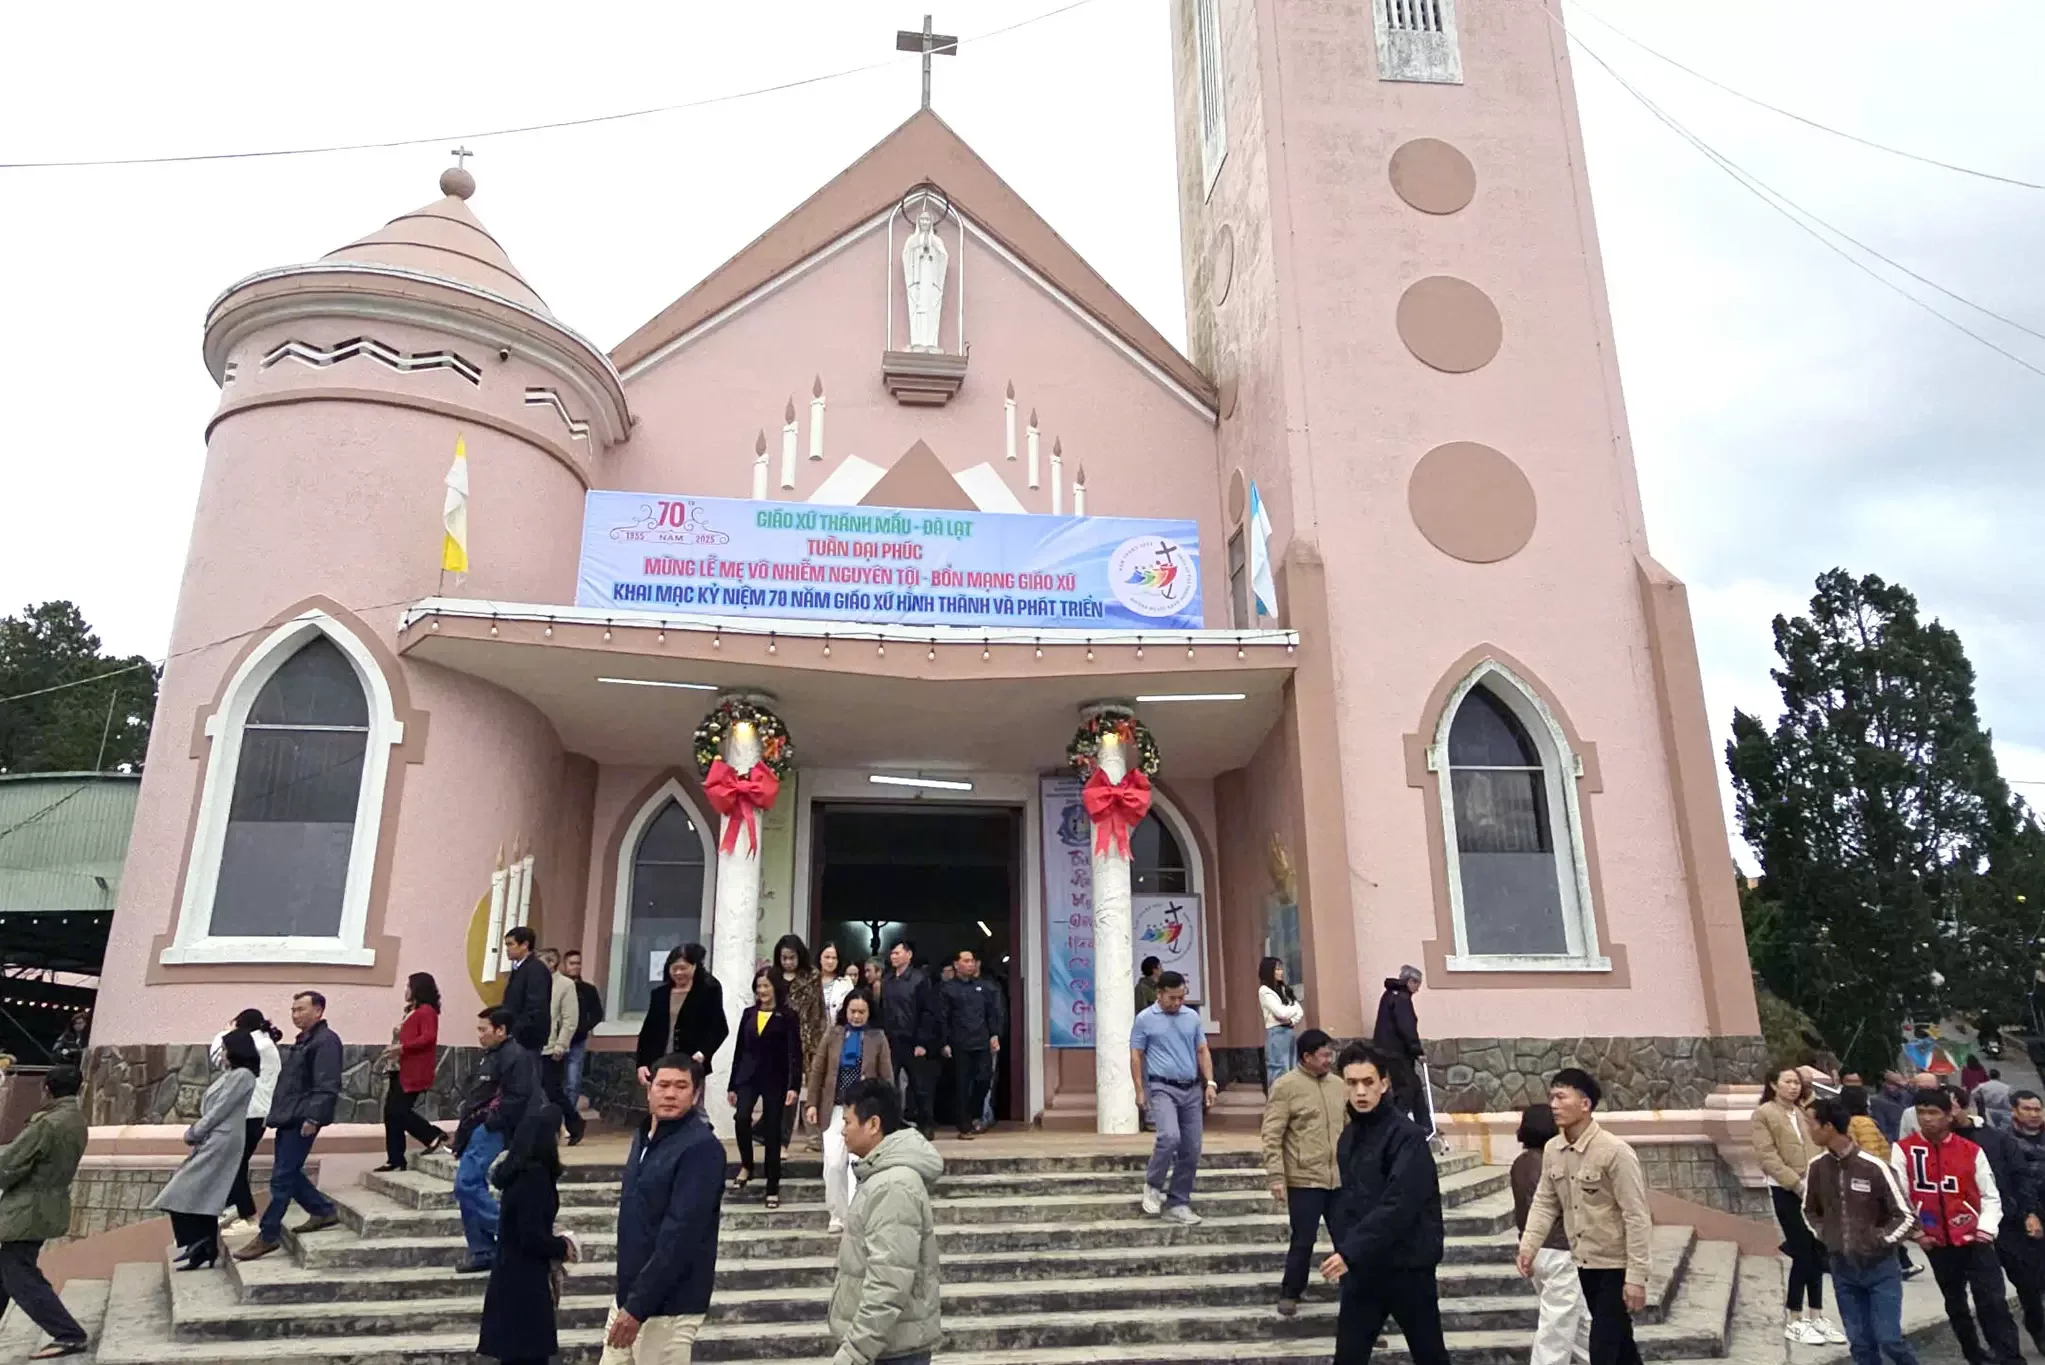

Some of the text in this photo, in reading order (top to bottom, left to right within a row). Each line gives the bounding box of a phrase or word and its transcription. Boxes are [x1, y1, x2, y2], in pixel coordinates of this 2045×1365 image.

[657, 501, 685, 528] 70
[696, 535, 715, 543] 2025
[719, 561, 745, 583] MẸ
[828, 565, 893, 585] NGUYÊN
[967, 572, 1015, 593] MẠNG
[613, 583, 652, 601] KHAI
[655, 585, 695, 607] MẠC
[722, 585, 766, 609] NIỆM
[769, 590, 787, 607] 70
[834, 590, 871, 609] GIÁO
[896, 592, 934, 612] HÌNH
[1017, 596, 1057, 616] PHÁT
[1059, 595, 1103, 618] TRIỂN
